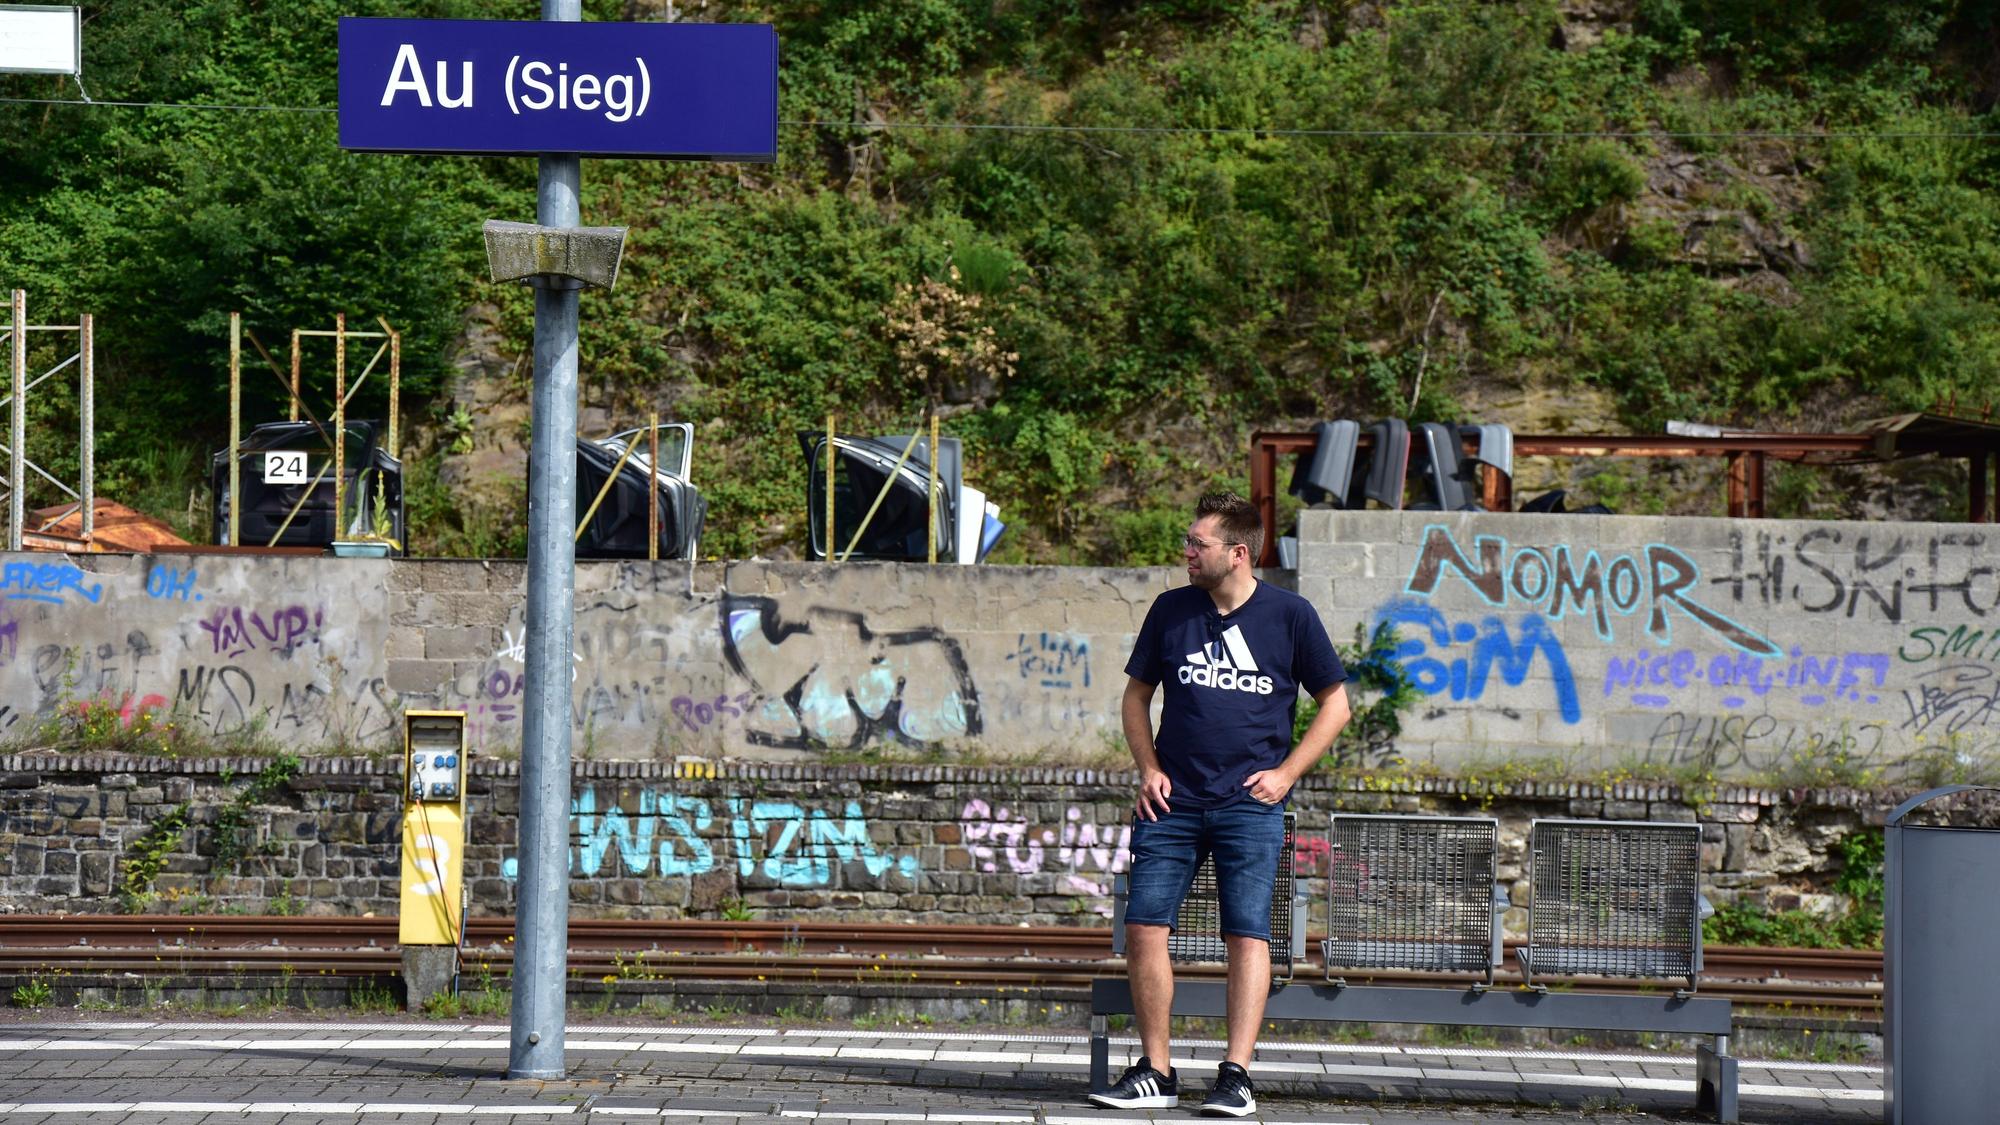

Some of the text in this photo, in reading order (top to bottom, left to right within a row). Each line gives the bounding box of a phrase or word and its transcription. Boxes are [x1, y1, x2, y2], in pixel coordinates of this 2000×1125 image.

[380, 44, 651, 122] Au (Sieg)
[269, 456, 302, 477] 24
[1404, 524, 1784, 658] NOMOR
[1178, 663, 1273, 695] adidas
